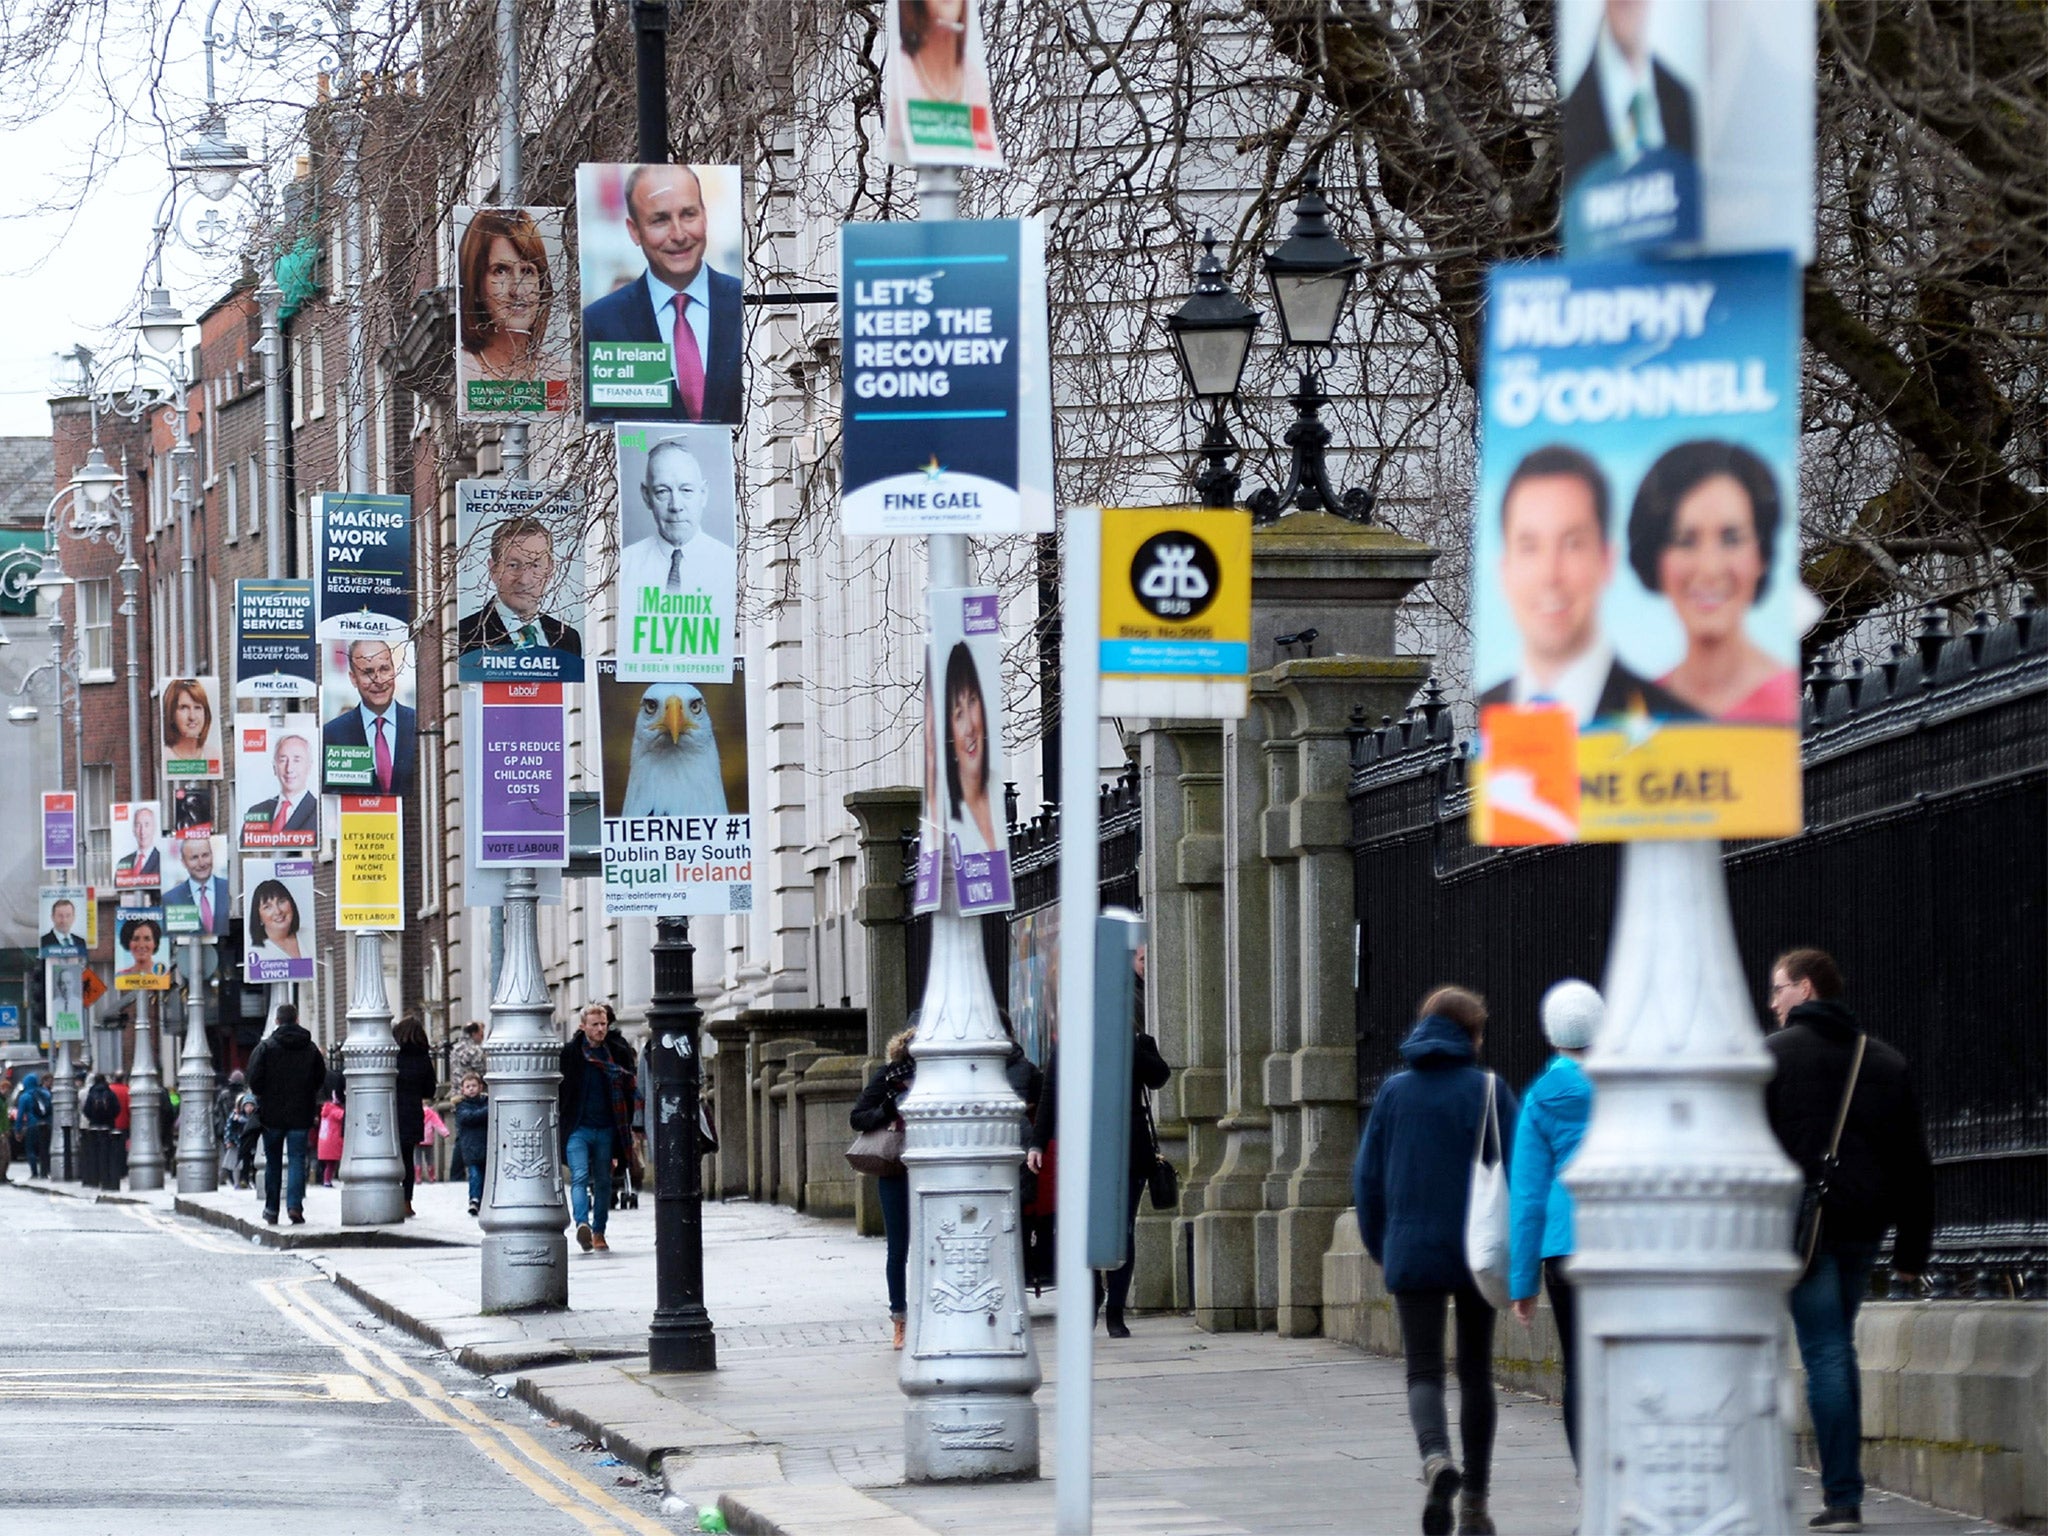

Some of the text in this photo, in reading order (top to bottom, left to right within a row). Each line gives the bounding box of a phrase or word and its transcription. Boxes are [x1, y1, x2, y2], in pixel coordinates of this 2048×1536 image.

[855, 278, 934, 306] LET'S
[855, 307, 993, 337] KEEP THE
[1494, 281, 1717, 352] MURPHY
[593, 347, 666, 361] An Ireland
[854, 338, 1009, 368] RECOVERY
[593, 364, 634, 378] for all
[854, 370, 950, 398] GOING
[1493, 357, 1779, 428] O'CONNELL
[473, 489, 508, 500] LET'S
[511, 490, 543, 500] KEEP
[884, 492, 982, 510] FINE GAEL
[466, 503, 577, 514] RECOVERY GOING
[328, 511, 404, 528] MAKING
[328, 529, 388, 545] WORK
[328, 547, 365, 562] PAY
[328, 576, 391, 586] LET'S KEEP THE
[328, 585, 401, 595] RECOVERY GOING
[243, 596, 311, 606] INVESTING
[643, 586, 713, 615] Mannix
[243, 608, 305, 618] IN PUBLIC
[243, 619, 304, 630] SERVICES
[340, 621, 390, 631] FINE GAEL
[632, 616, 720, 655] FLYNN
[482, 656, 561, 670] FINE GAEL
[624, 663, 638, 672] THE
[642, 663, 670, 673] DUBLIN
[673, 664, 726, 674] INDEPENDENT
[509, 684, 539, 697] Labour
[488, 741, 561, 752] LET'S REDUCE
[327, 748, 370, 759] An Ireland
[327, 759, 352, 768] for all
[504, 756, 543, 766] GP AND
[495, 770, 553, 780] CHILDCARE
[507, 784, 541, 794] COSTS
[1637, 768, 1741, 804] GAEL
[604, 818, 751, 842] TIERNEY #1
[244, 831, 313, 845] Humphreys
[343, 833, 395, 841] LET'S REDUCE
[487, 843, 560, 853] VOTE LABOUR
[342, 853, 396, 861] LOW & MIDDLE
[604, 844, 752, 865] Dublin Bay South
[352, 874, 387, 882] EARNERS
[605, 861, 752, 889] Equal Ireland
[606, 903, 659, 913] @eointierney
[343, 913, 395, 921] VOTE LABOUR
[249, 952, 289, 970] 1 Glenna
[261, 970, 289, 979] LYNCH
